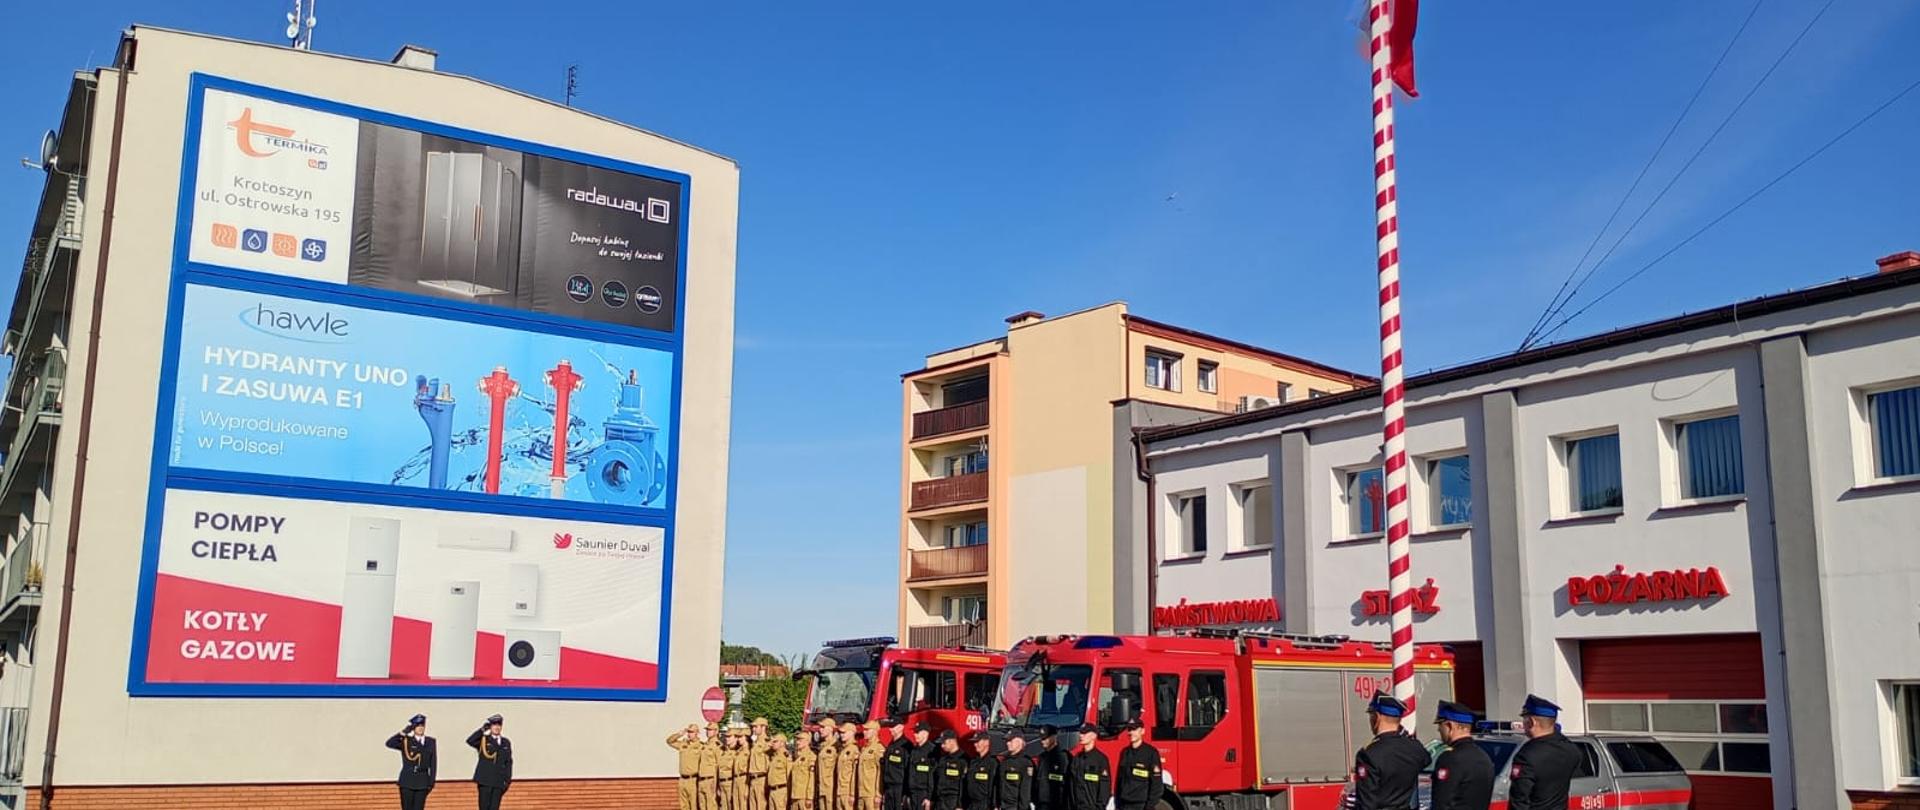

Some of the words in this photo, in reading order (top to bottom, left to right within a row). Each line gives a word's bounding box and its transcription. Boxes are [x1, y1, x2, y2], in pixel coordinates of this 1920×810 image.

[265, 137, 329, 156] TERMIKA
[233, 175, 313, 201] Krotoszyn
[201, 189, 220, 204] ul.
[224, 193, 309, 218] Ostrowska
[314, 208, 341, 223] 195
[567, 186, 645, 219] radaway
[257, 303, 349, 337] hawle
[204, 346, 347, 380] HYDRANTY
[354, 364, 408, 387] UNO
[201, 374, 209, 393] I
[215, 375, 329, 406] ZASUWA
[335, 389, 364, 409] E1
[200, 410, 348, 440] Wyprodukowane
[198, 437, 214, 449] w
[220, 435, 284, 455] Polsce!
[194, 511, 286, 534] POMPY
[191, 540, 278, 562] CIEPŁA
[576, 537, 618, 550] Saunier
[620, 540, 650, 552] Duval
[1360, 578, 1441, 616] STAŻ
[1567, 564, 1730, 606] POŻARNA
[184, 609, 268, 632] KOTŁY
[1154, 598, 1280, 631] PAŃSTWOWA
[181, 639, 296, 661] GAZOWE
[965, 714, 982, 730] 491
